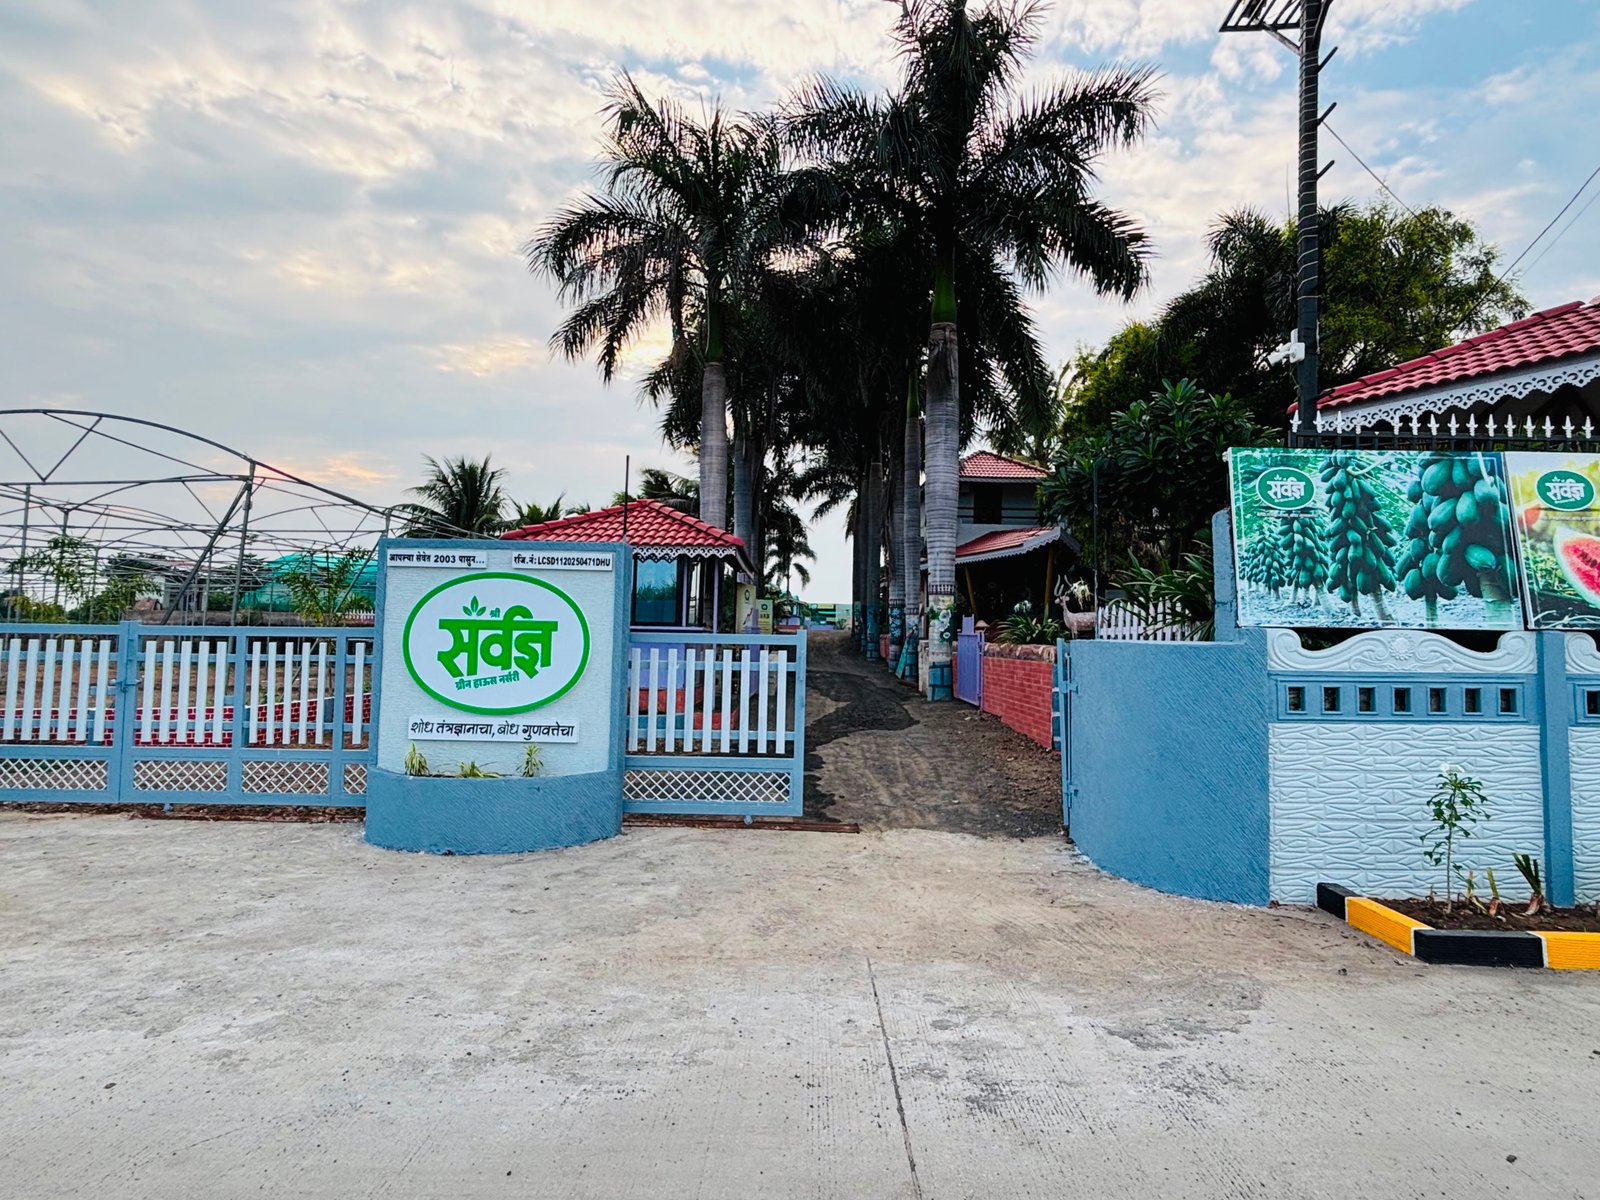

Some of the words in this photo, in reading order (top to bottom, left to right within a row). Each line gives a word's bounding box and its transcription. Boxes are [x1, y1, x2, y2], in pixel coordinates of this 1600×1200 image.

[434, 554, 456, 564] 2003
[490, 607, 501, 618] श्री
[437, 605, 559, 679] सर्वज्ञ
[455, 678, 472, 691] ग्रीन
[473, 676, 498, 689] हाऊस
[498, 670, 520, 684] नर्सरी
[411, 718, 435, 734] शोध
[436, 719, 496, 738] तंत्रज्ञानाचा,
[497, 720, 520, 736] बोध
[522, 721, 575, 741] गुणवत्तेचा
